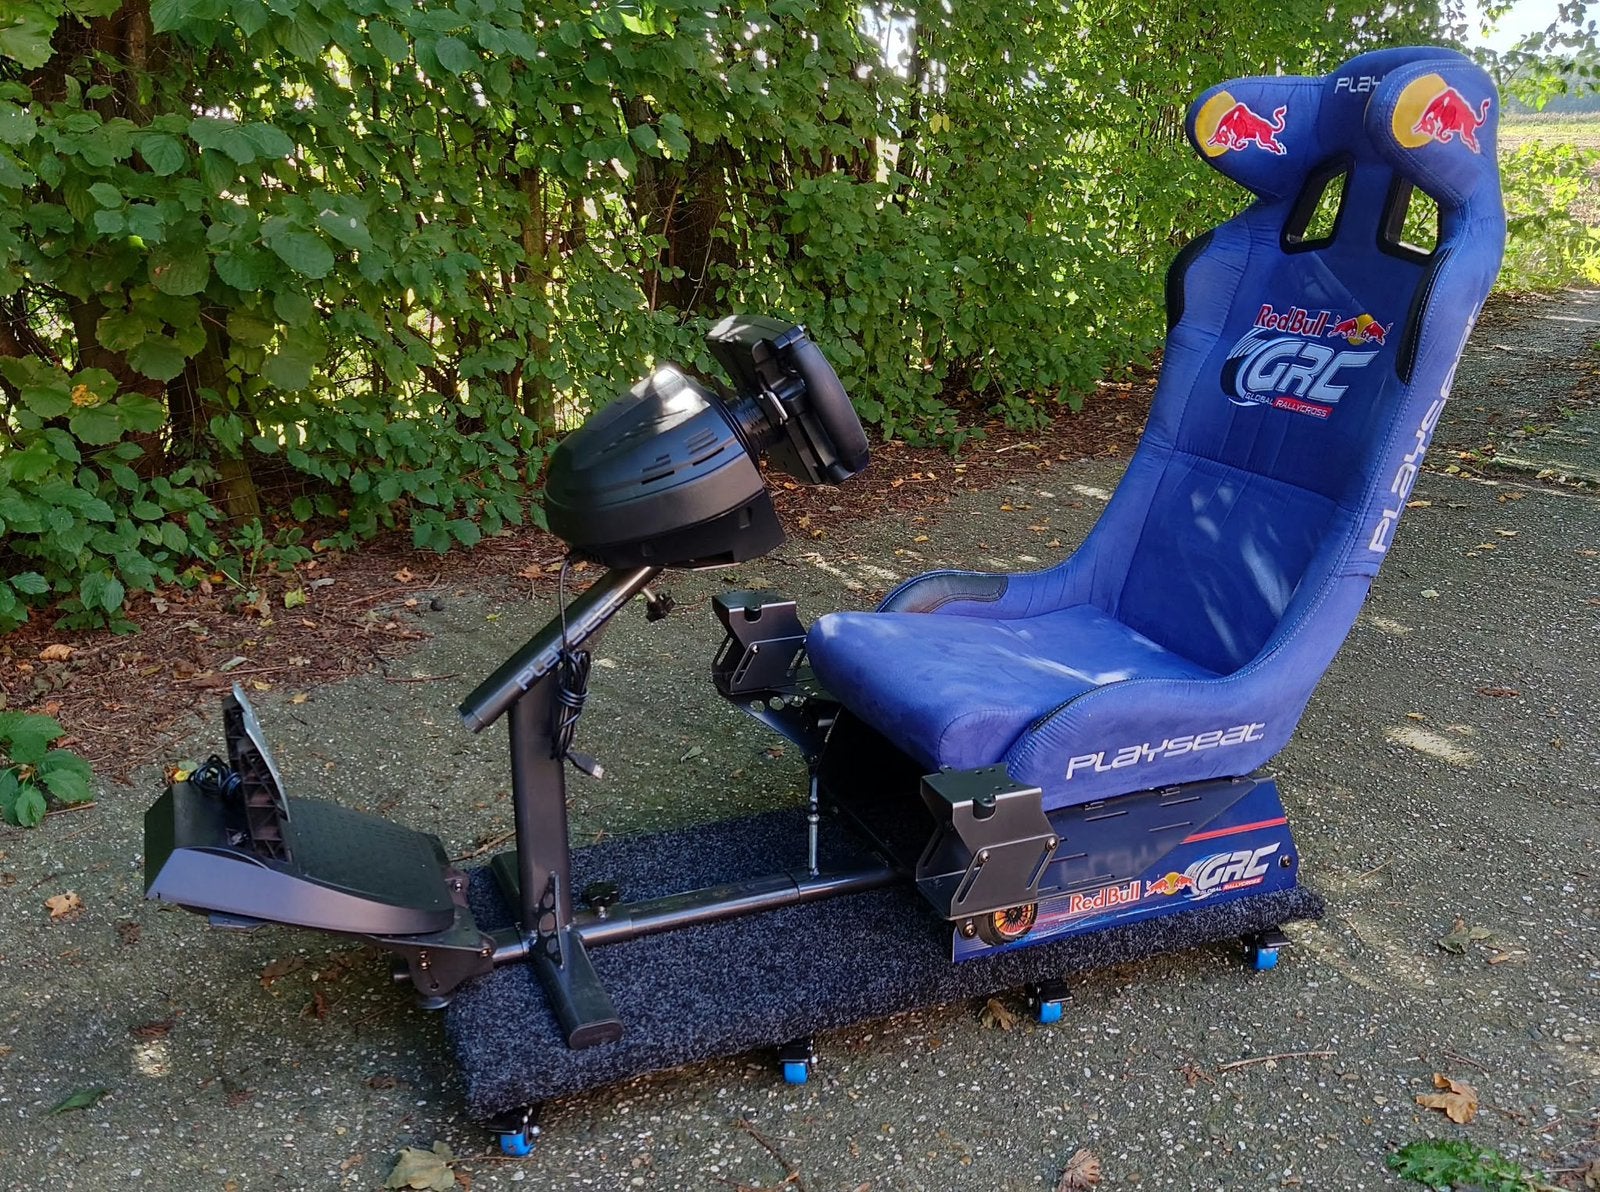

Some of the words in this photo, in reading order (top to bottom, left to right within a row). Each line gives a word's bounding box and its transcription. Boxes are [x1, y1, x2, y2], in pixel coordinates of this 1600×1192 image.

[1247, 341, 1380, 403] GRC
[1244, 392, 1274, 406] GLOBAL
[1275, 399, 1328, 418] RALLYCROSS
[1197, 841, 1281, 892] GRC
